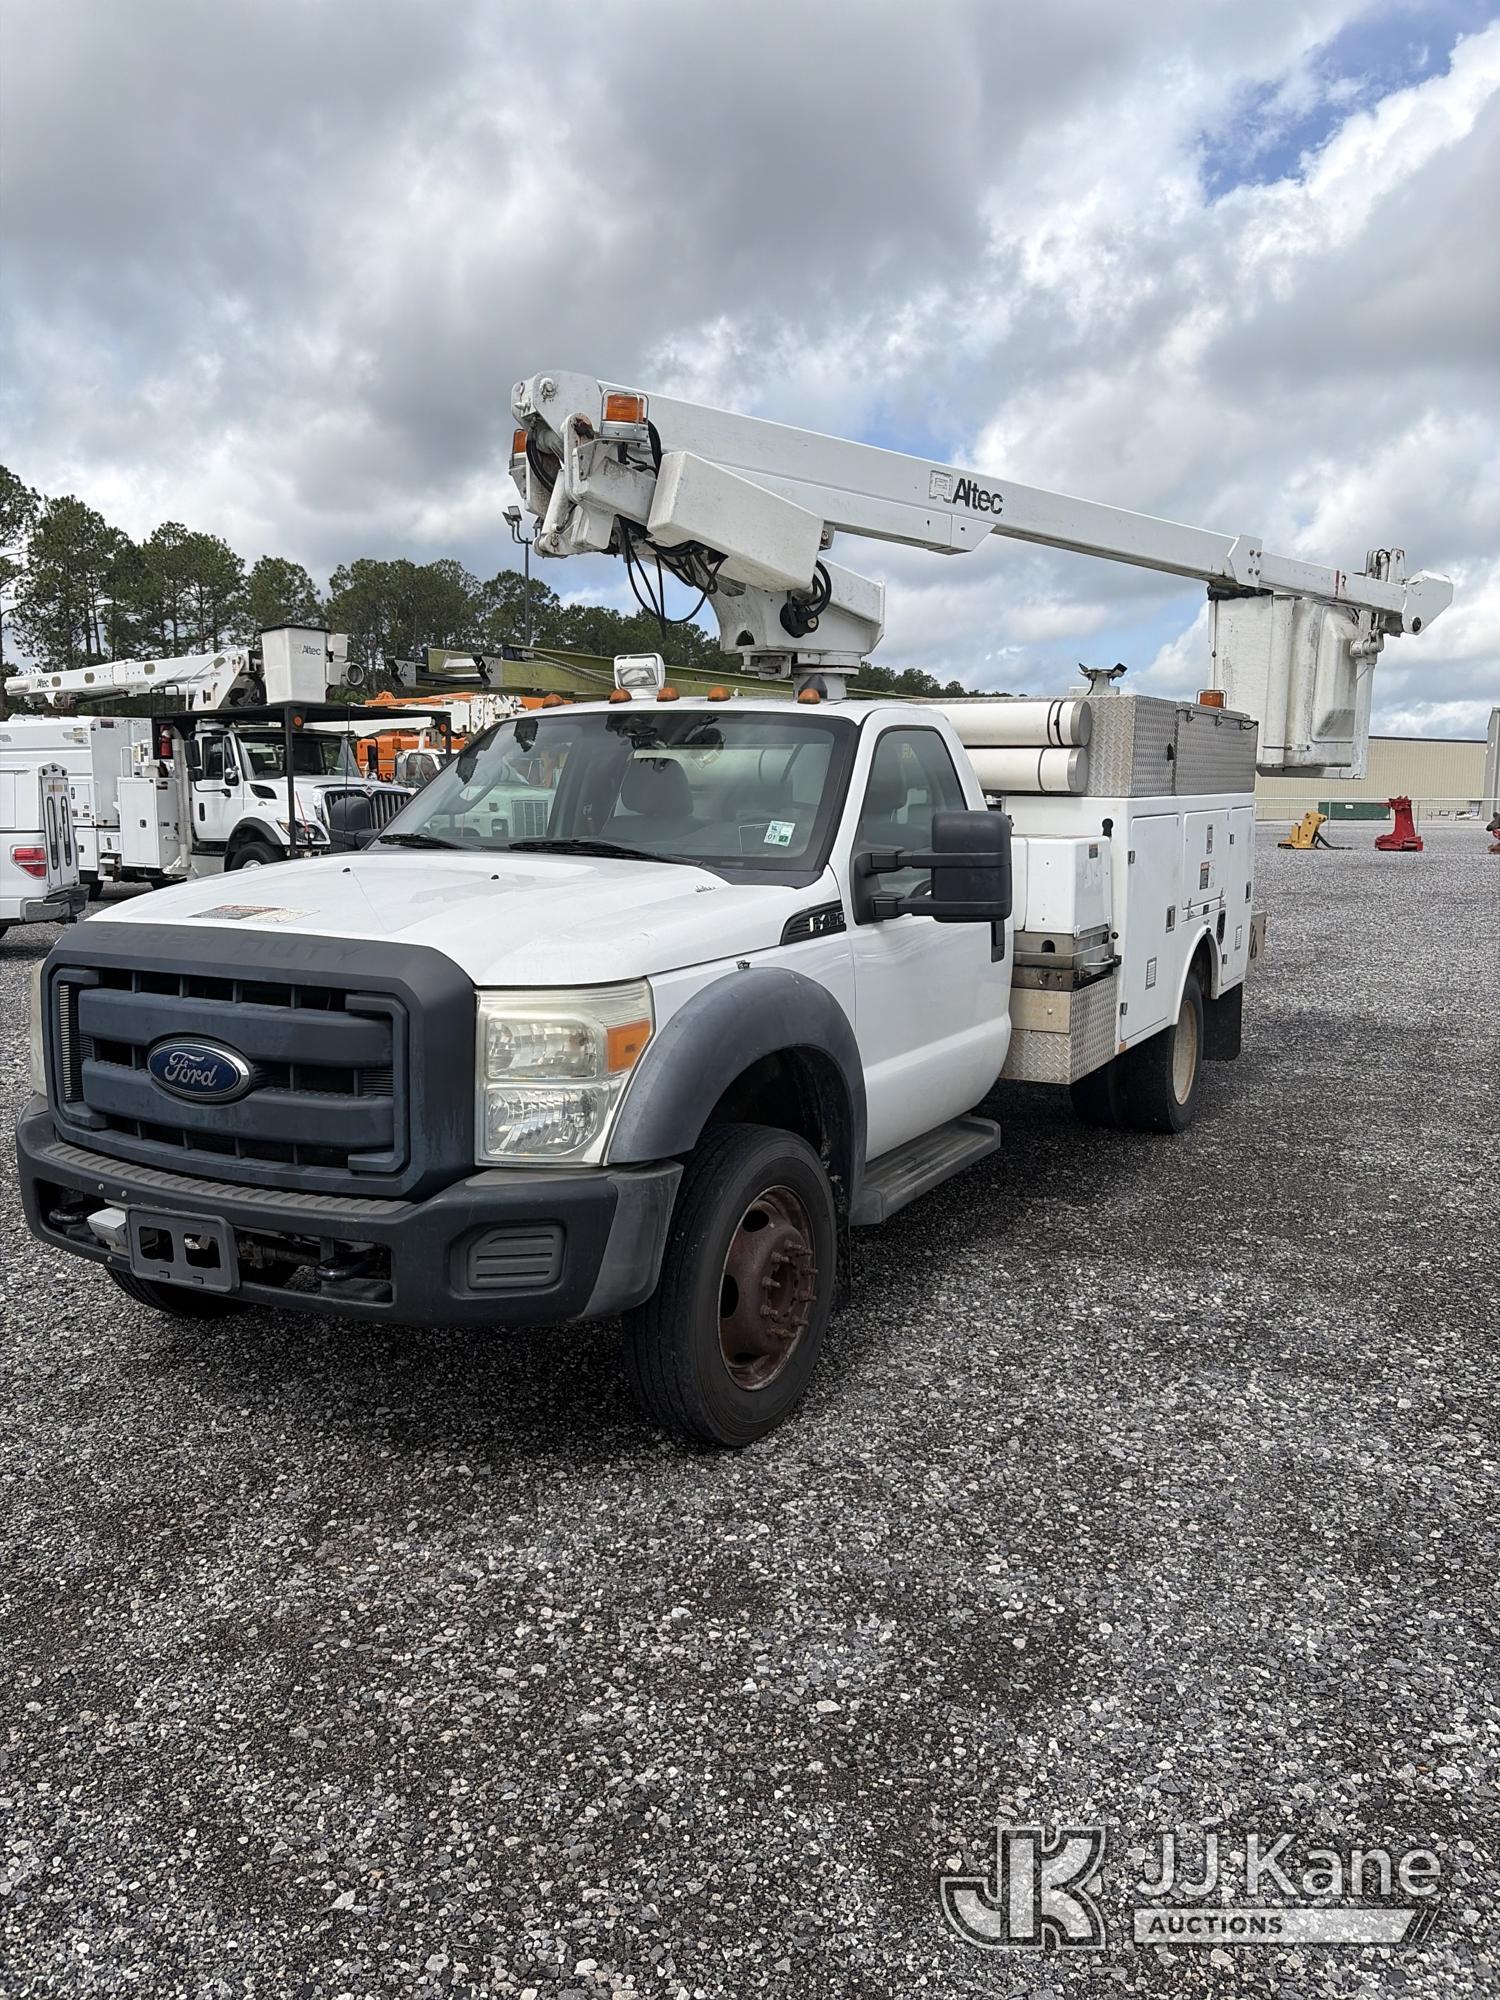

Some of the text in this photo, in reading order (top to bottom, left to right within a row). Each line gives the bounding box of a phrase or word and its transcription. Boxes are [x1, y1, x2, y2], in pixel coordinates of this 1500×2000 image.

[952, 477, 1004, 515] Altec
[301, 644, 322, 656] Altec
[36, 678, 50, 688] Altec
[231, 939, 365, 961] DUTY
[164, 1051, 218, 1087] Ford
